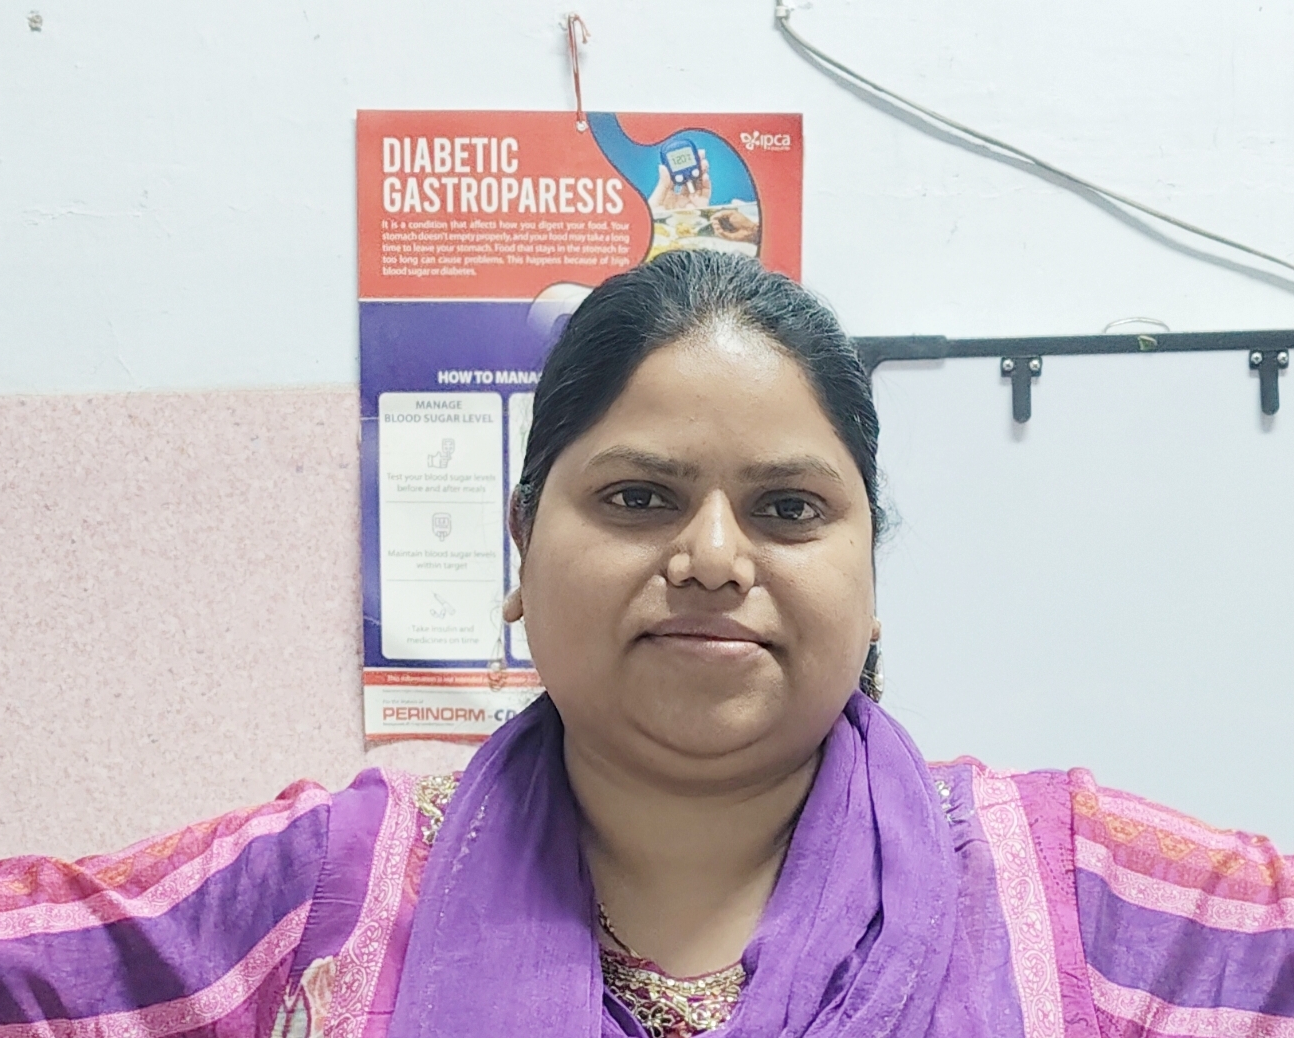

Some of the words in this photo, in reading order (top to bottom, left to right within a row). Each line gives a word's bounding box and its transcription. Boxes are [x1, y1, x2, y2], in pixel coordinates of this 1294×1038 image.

[383, 137, 519, 173] DIABETIC
[383, 176, 624, 214] GASTROPARESIS
[437, 370, 473, 384] HOW
[474, 370, 494, 384] TO
[415, 401, 462, 410] MANAGE
[384, 414, 421, 423] BLOOD
[423, 414, 460, 423] SUGAR
[462, 414, 494, 423] LEVEL
[387, 473, 403, 482] Test
[405, 474, 423, 483] your
[424, 473, 448, 482] blood
[450, 474, 472, 484] sugar
[473, 473, 496, 482] levels
[397, 484, 423, 492] before
[425, 484, 440, 493] and
[442, 484, 462, 493] after
[463, 484, 486, 493] meals
[387, 549, 423, 558] Maintain
[424, 549, 448, 558] blood
[450, 551, 472, 560] sugar
[473, 550, 497, 559] levels
[416, 561, 442, 570] within
[443, 562, 468, 572] target
